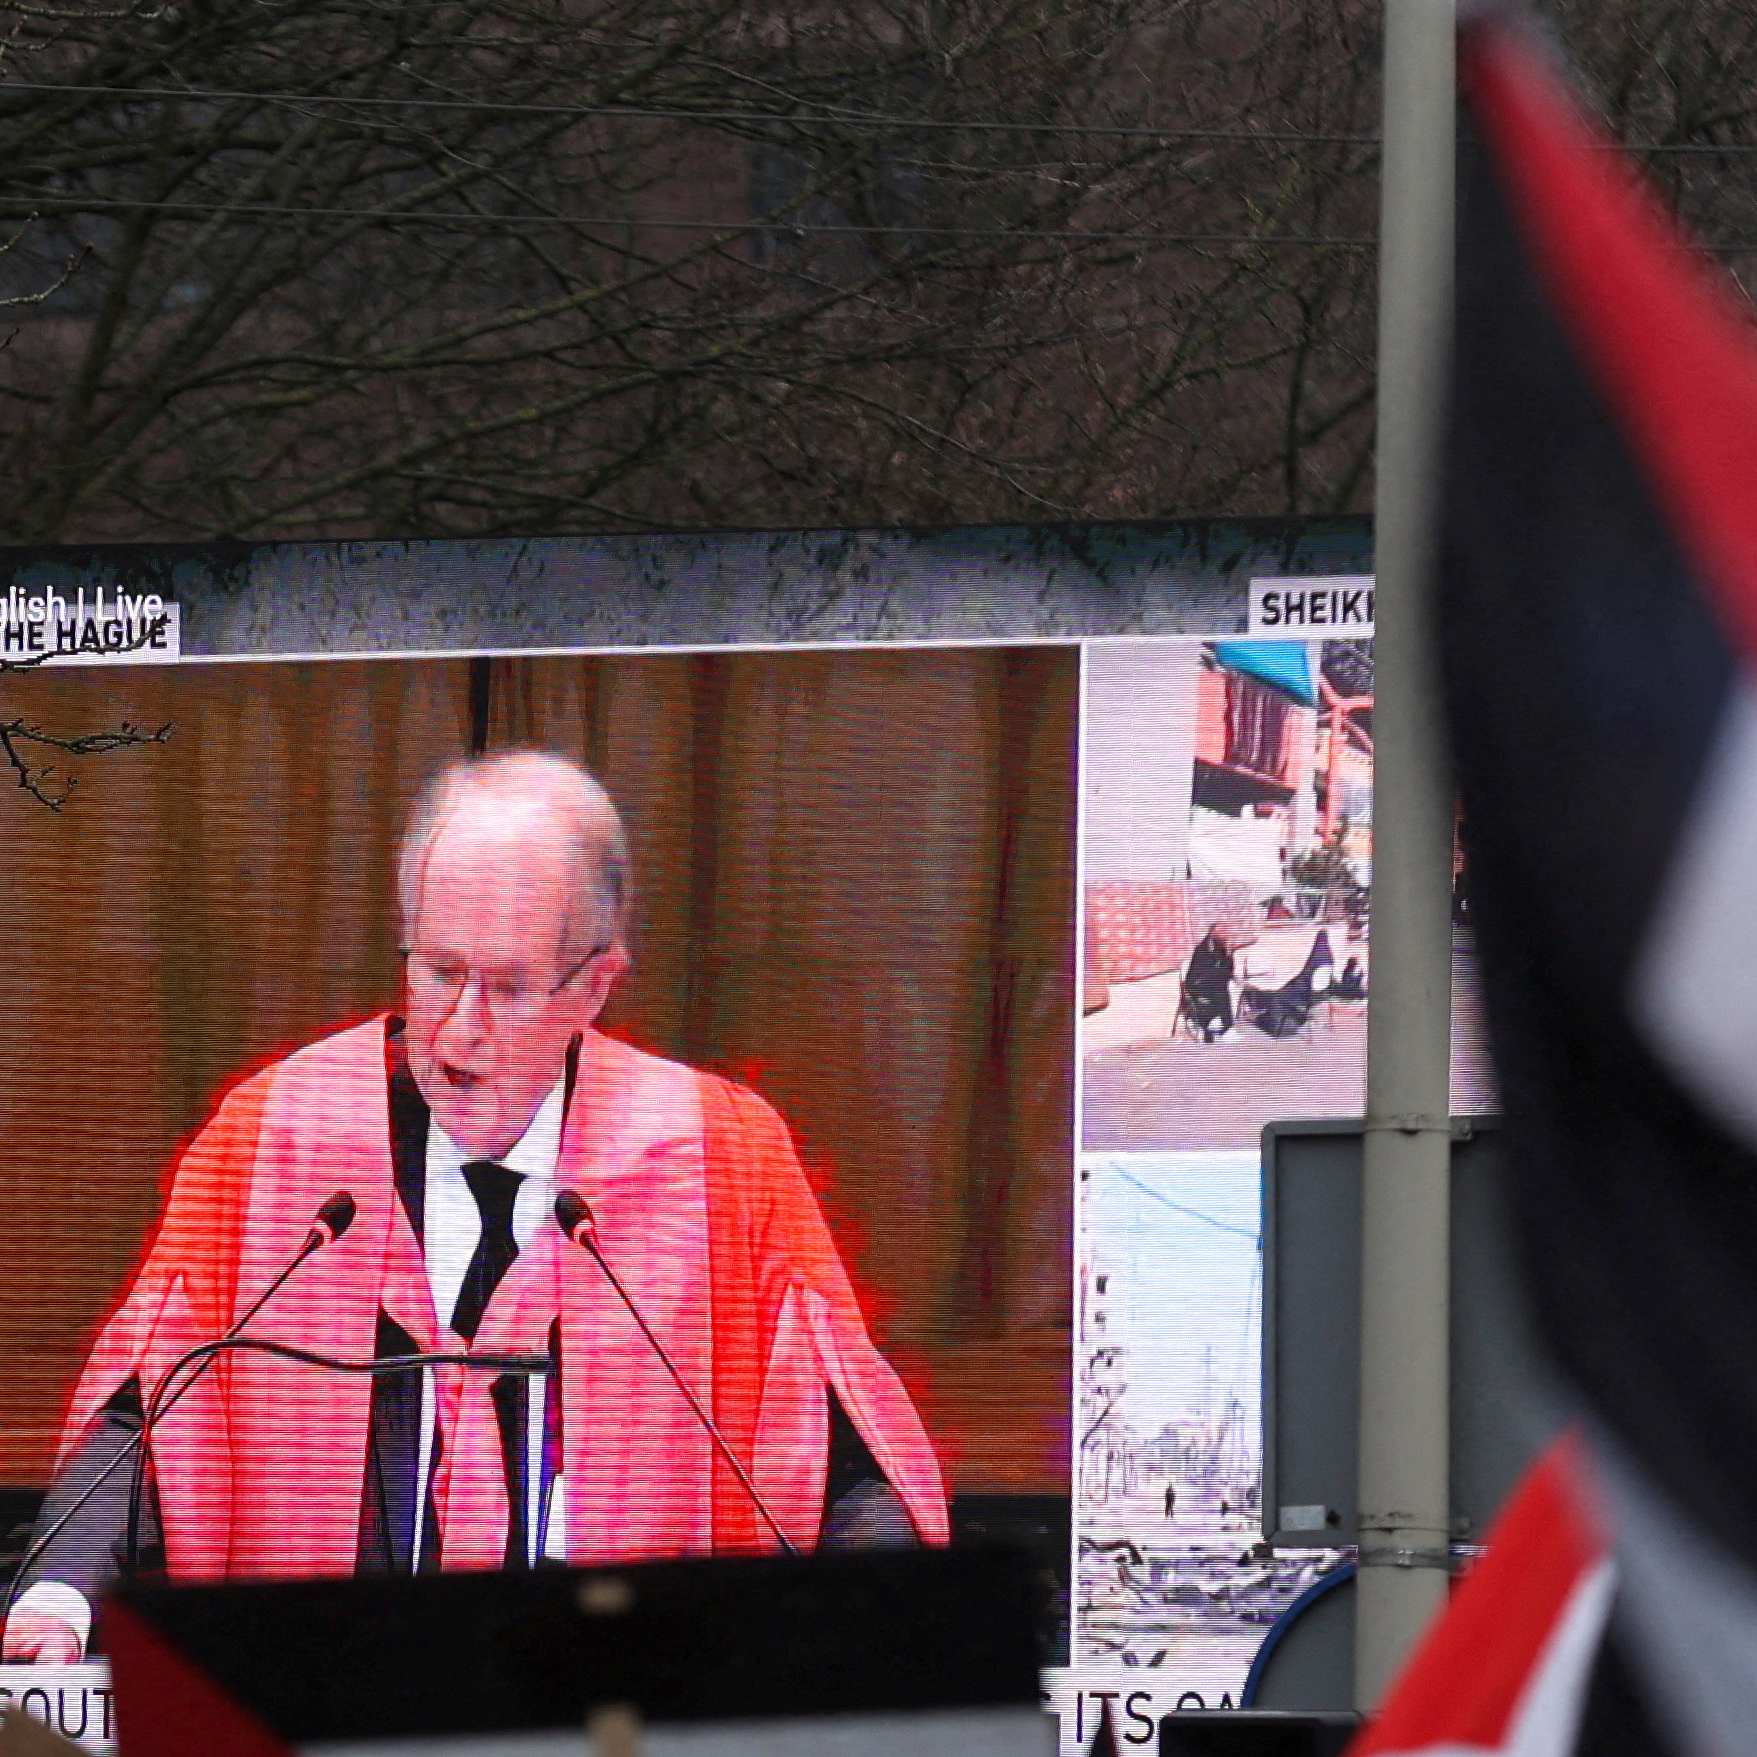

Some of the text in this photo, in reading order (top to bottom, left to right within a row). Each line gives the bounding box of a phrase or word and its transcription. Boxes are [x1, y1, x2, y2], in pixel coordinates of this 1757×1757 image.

[96, 585, 163, 621] Live
[57, 617, 168, 650] HAGUE
[1076, 1690, 1154, 1744] ITS
